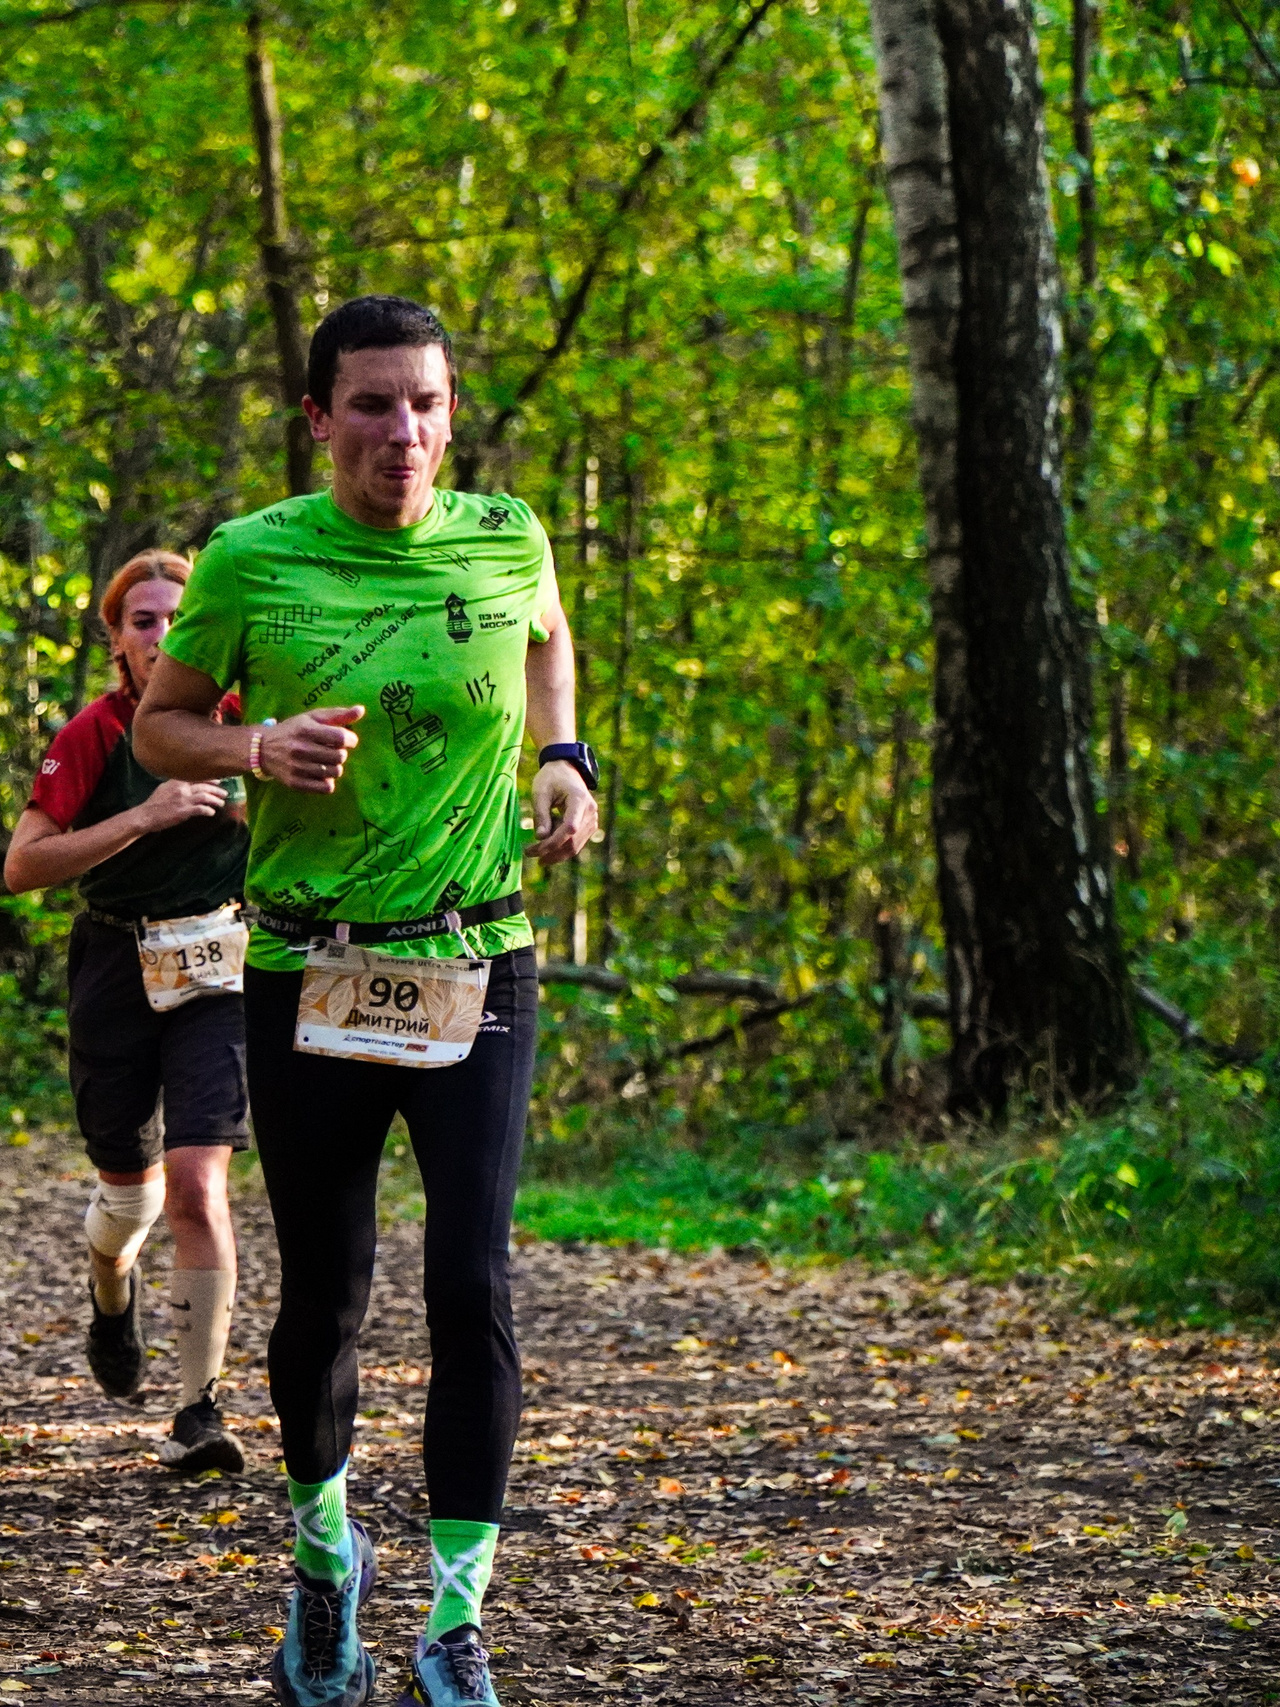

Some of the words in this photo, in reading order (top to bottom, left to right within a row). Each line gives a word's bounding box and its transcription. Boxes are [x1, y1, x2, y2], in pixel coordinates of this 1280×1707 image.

[297, 643, 342, 680] МОСКВА
[386, 918, 447, 937] AONIJ
[177, 941, 223, 970] 138
[369, 977, 419, 1012] 90
[345, 1009, 430, 1034] Дмитрий
